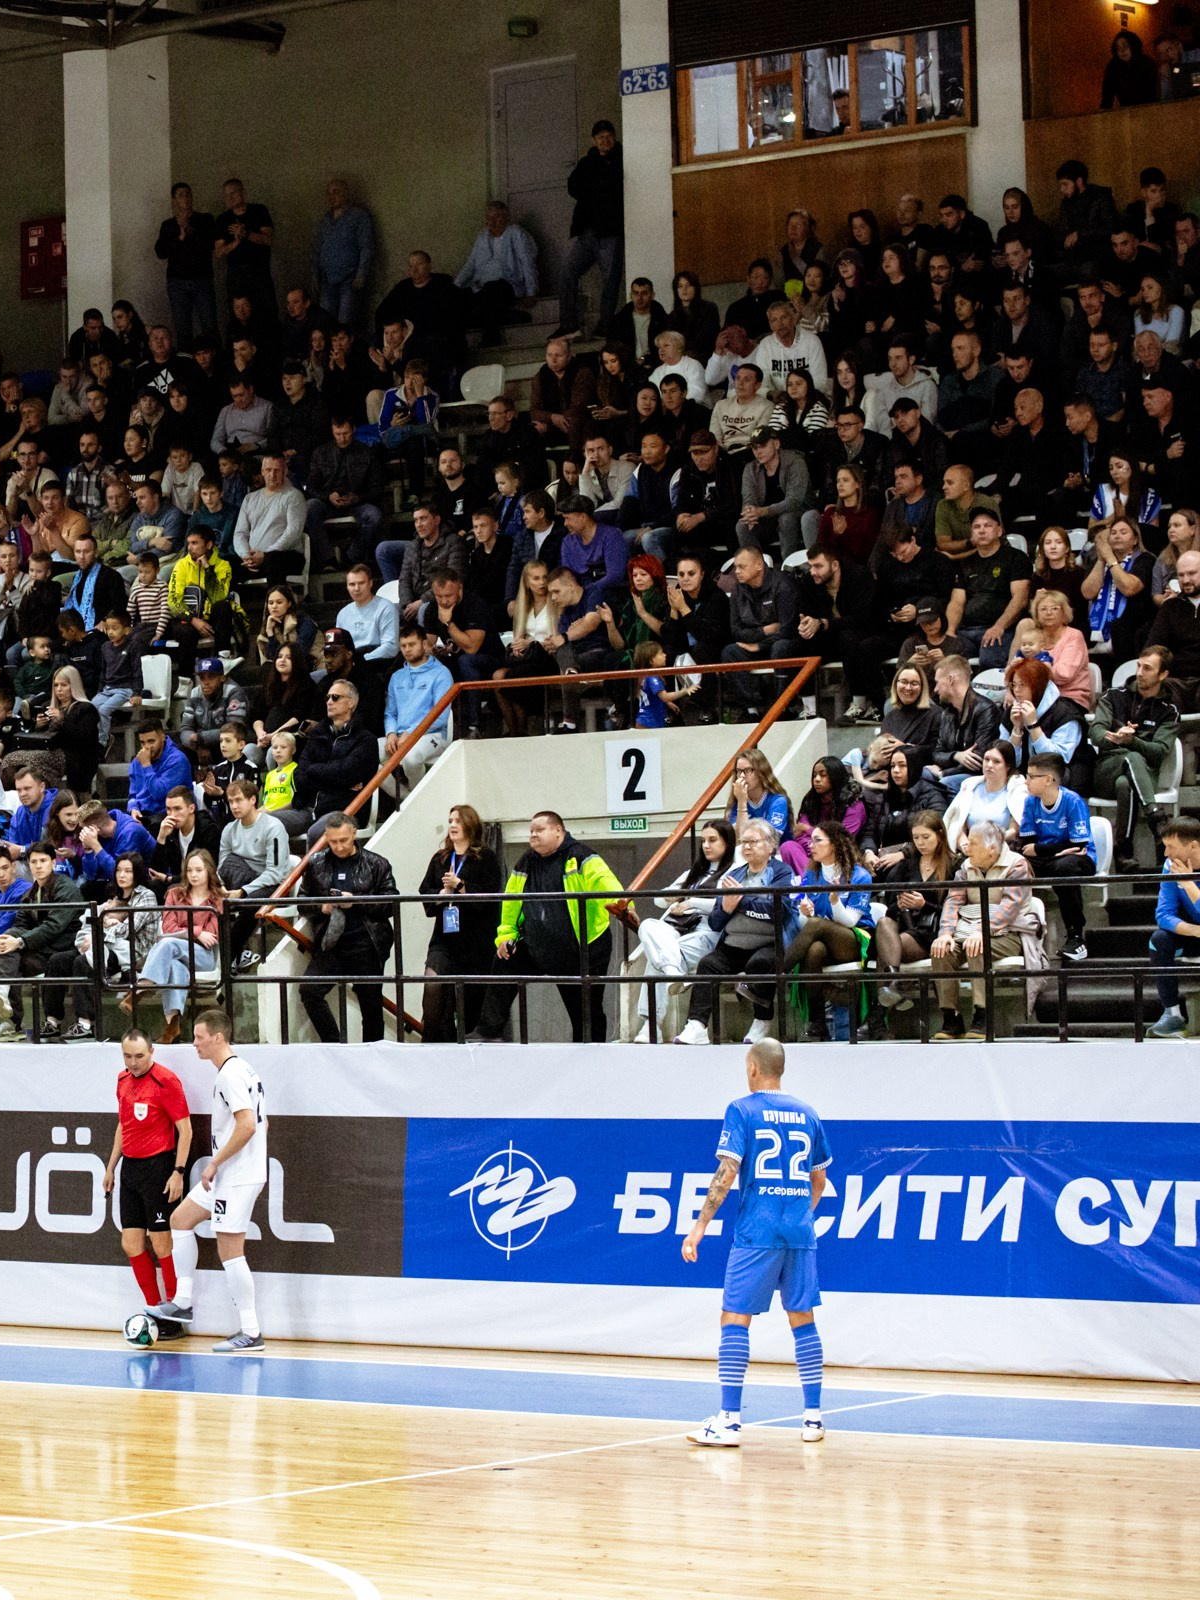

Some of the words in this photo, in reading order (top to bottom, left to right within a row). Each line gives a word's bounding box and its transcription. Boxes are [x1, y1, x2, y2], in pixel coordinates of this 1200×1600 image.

[622, 71, 668, 94] 62-63
[621, 748, 647, 801] 2
[613, 818, 644, 830] ВЫХОД
[754, 1128, 811, 1182] 22
[613, 1171, 1026, 1243] БЕСИТИ
